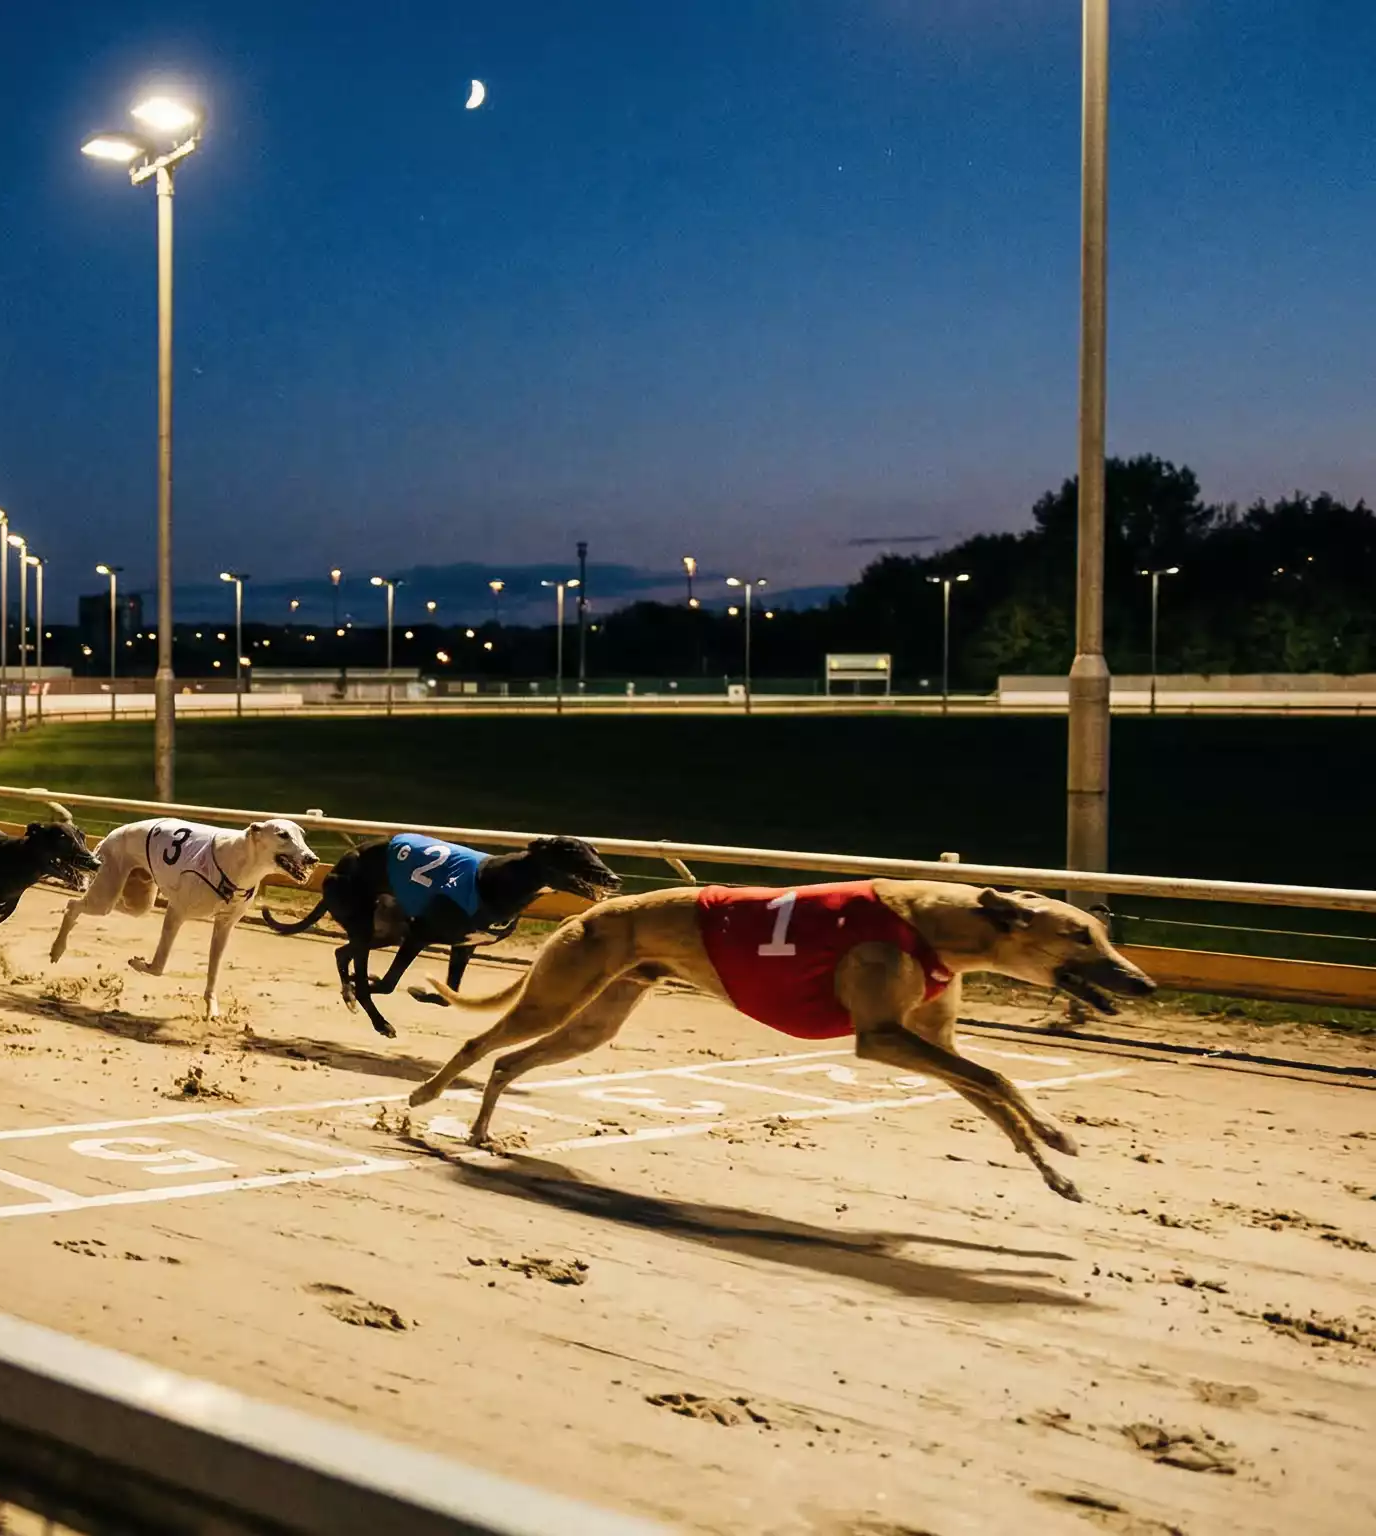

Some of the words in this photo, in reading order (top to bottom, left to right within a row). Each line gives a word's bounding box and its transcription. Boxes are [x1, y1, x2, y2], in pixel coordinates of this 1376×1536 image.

[163, 827, 193, 866] 3
[411, 845, 451, 888] 2
[758, 891, 797, 956] 1
